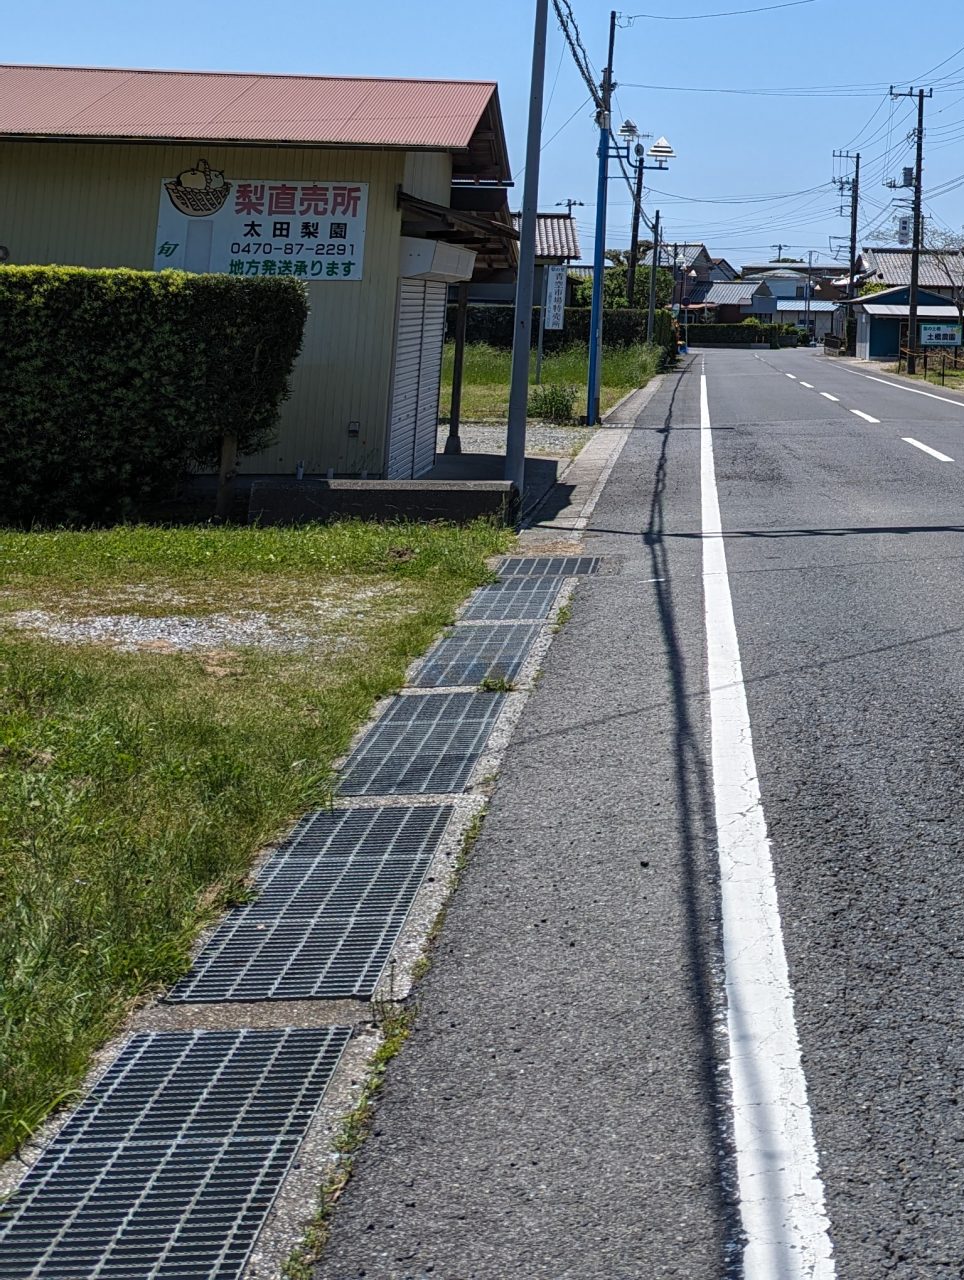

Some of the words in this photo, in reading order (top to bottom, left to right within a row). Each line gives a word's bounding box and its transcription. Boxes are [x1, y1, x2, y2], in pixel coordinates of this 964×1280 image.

[235, 183, 362, 218] 梨直売所
[243, 220, 348, 239] 太田梨園
[157, 240, 179, 258] 旬
[230, 242, 355, 256] 0470-87-2291
[229, 259, 356, 277] 地方発送承ります
